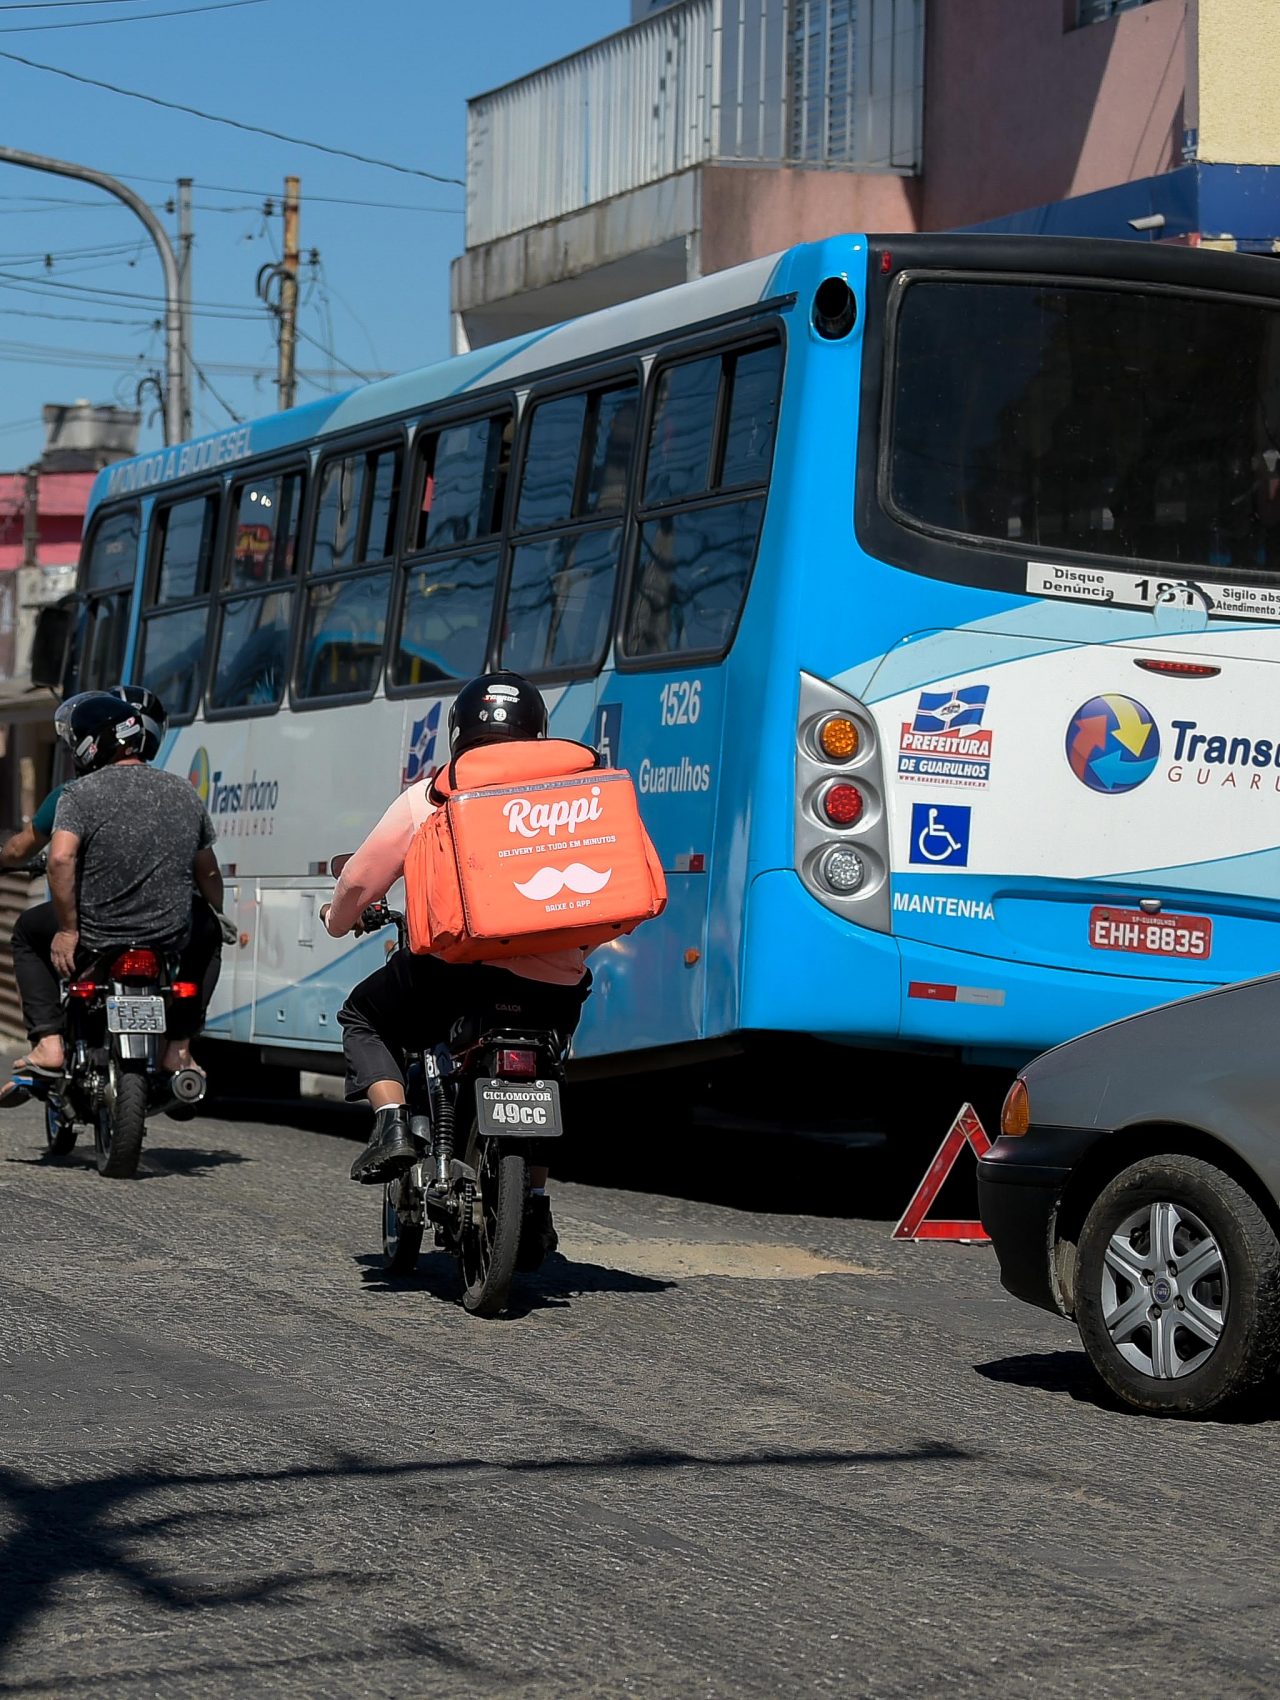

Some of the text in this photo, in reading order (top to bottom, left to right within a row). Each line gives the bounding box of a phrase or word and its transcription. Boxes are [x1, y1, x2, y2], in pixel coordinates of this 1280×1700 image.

[1052, 566, 1105, 584] Disque
[1042, 579, 1115, 600] Denúncia
[1222, 587, 1280, 603] Sigilo abs
[1215, 599, 1276, 615] Atendimento
[659, 679, 702, 727] 1526
[901, 733, 990, 756] PREFEITURA
[639, 757, 711, 794] Guarulhos
[900, 758, 988, 777] DE GUARULHOS
[210, 768, 279, 814] Transurbano
[502, 786, 604, 838] Rappi
[498, 835, 617, 858] DELIVERY DE TUDO EM MINUTOS
[545, 899, 591, 912] BAIXE O APP
[893, 892, 995, 920] MANTENHA
[119, 1018, 158, 1031] 1223
[482, 1091, 552, 1101] CICLOMOTOR
